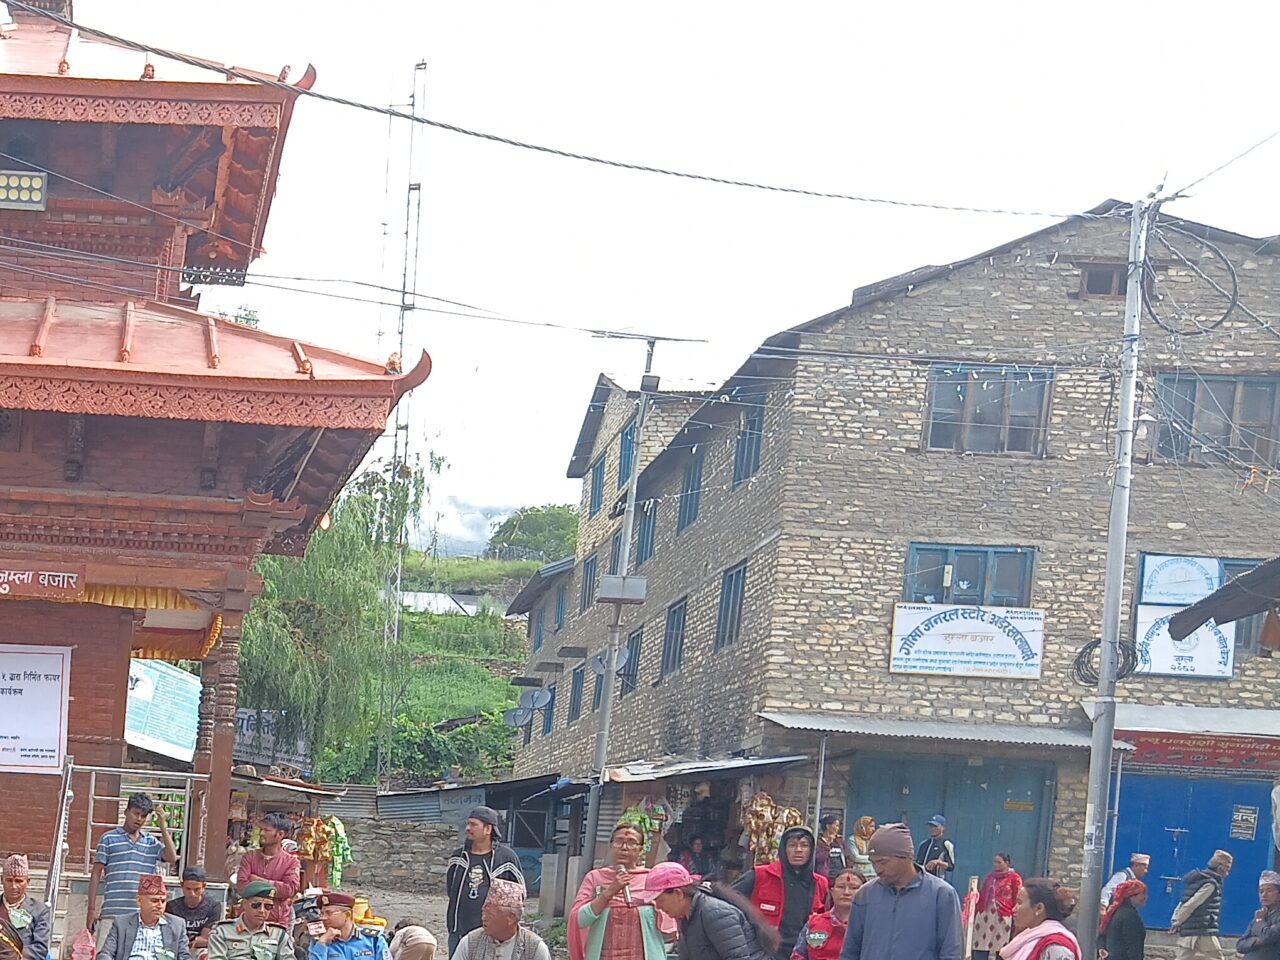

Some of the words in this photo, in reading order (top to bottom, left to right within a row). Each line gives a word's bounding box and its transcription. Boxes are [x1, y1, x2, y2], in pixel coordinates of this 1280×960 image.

[38, 571, 78, 589] बजार
[921, 608, 960, 632] जनरल
[960, 606, 988, 622] स्टोर
